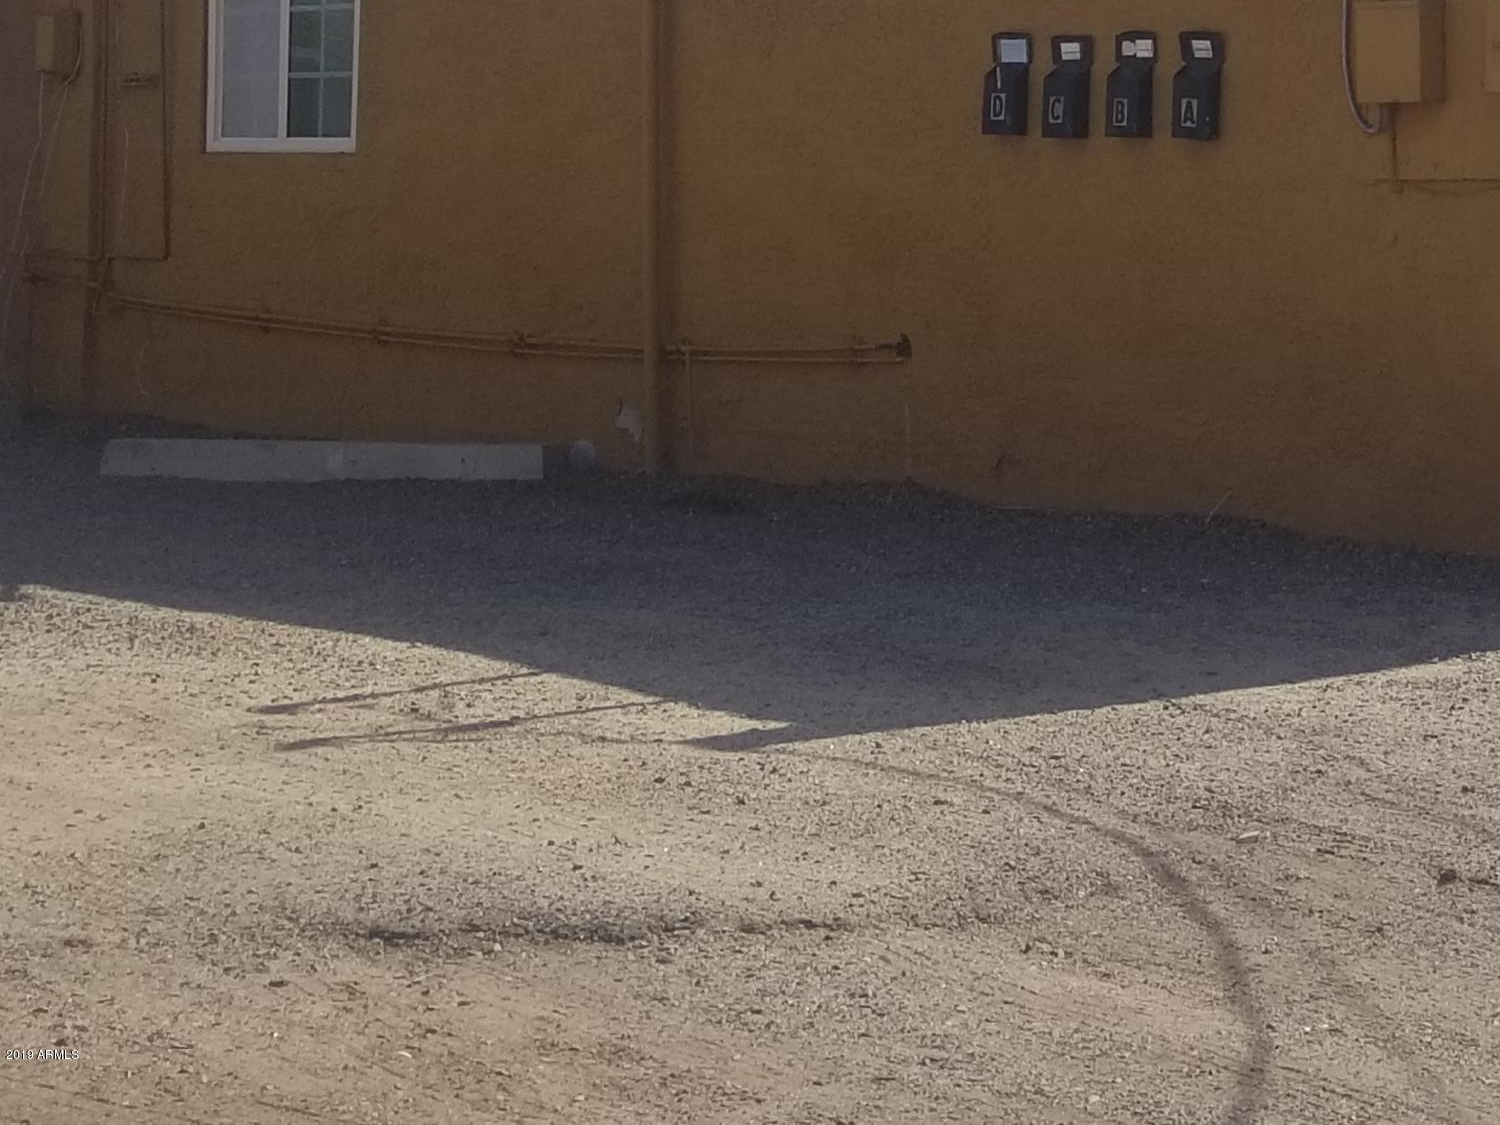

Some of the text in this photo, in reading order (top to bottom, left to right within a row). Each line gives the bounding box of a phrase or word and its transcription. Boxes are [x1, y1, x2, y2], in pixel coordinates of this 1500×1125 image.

[992, 94, 1004, 119] D
[1050, 97, 1062, 122] C
[1114, 99, 1126, 125] B
[1182, 99, 1196, 125] A
